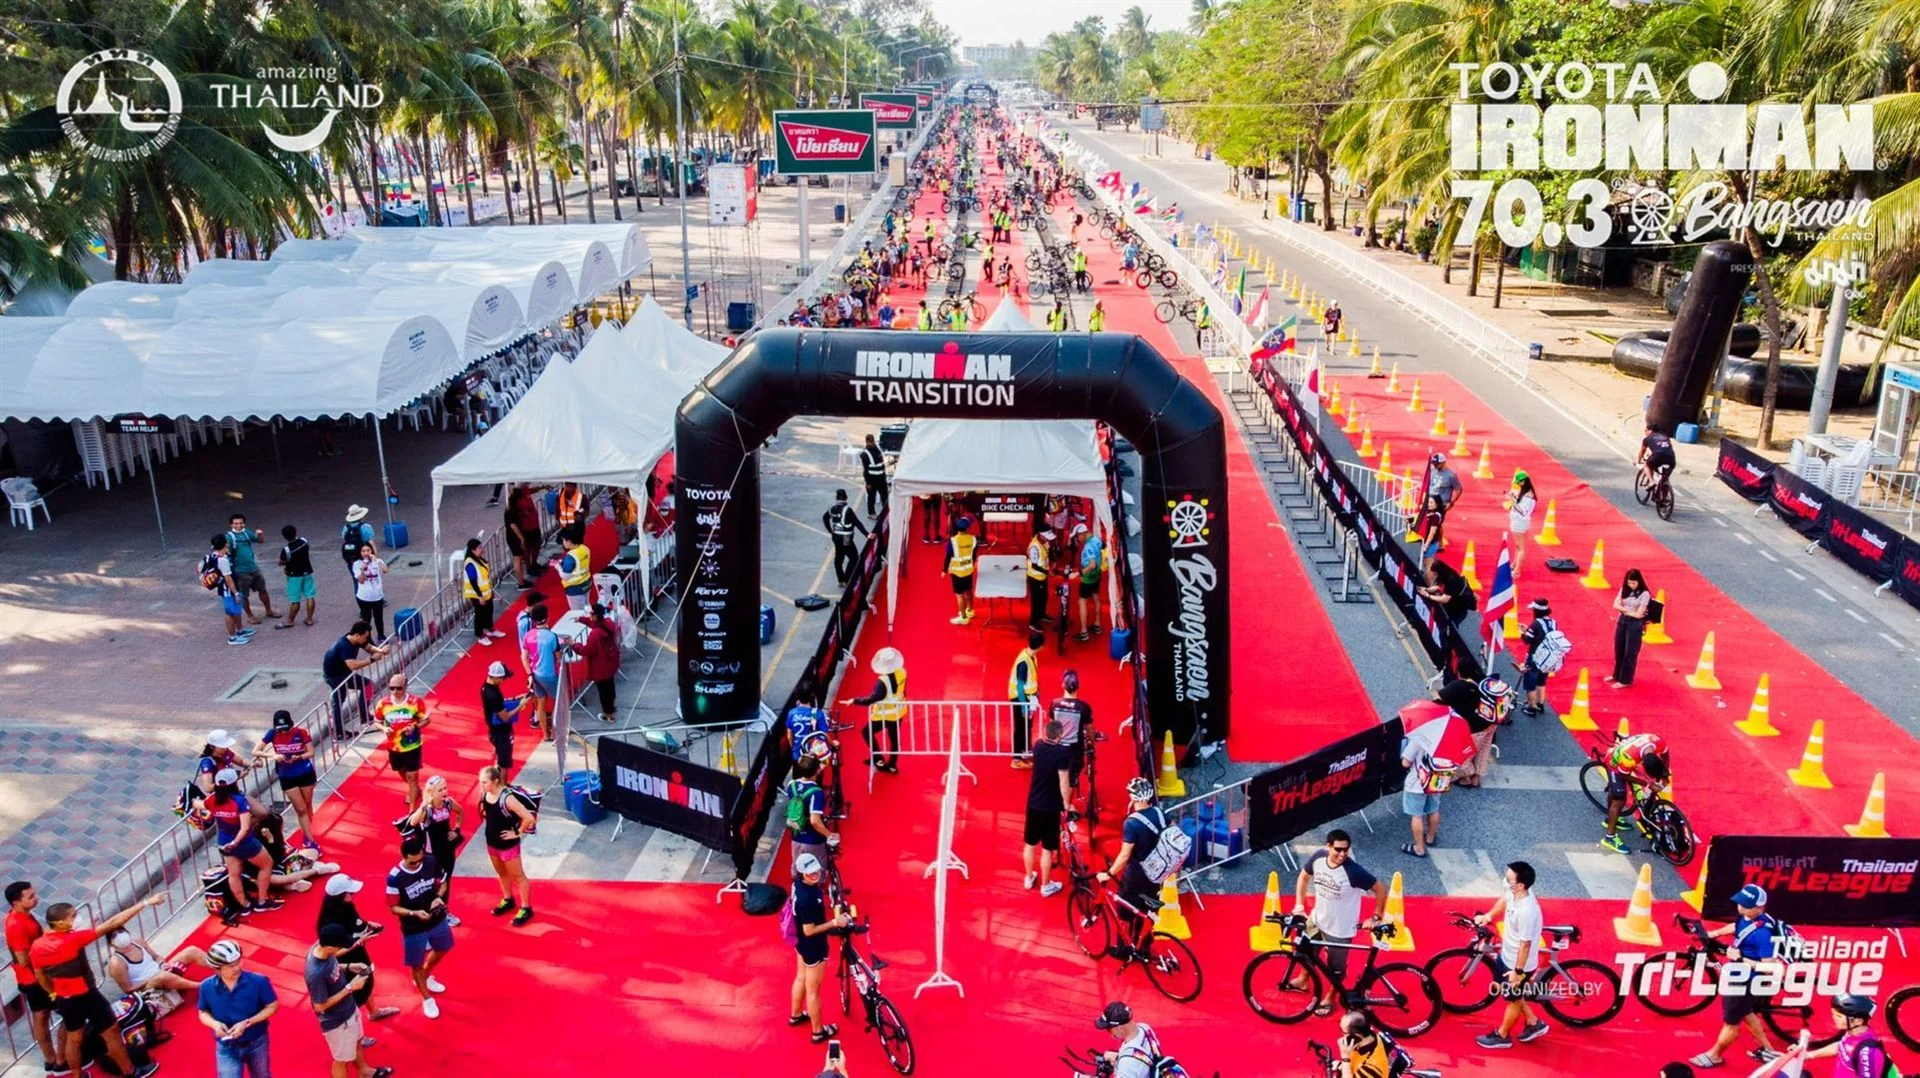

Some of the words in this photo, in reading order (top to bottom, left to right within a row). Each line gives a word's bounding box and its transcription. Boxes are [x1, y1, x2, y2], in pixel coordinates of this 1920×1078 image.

[855, 350, 1012, 381] IRONMAN
[849, 380, 1015, 406] TRANSITION
[685, 487, 732, 500] TOYOTA
[1168, 553, 1217, 701] Bangsaen
[1173, 642, 1184, 702] THAILAND
[1328, 747, 1367, 774] Thailand
[616, 765, 723, 818] IRONMAN
[1271, 762, 1366, 815] Tri-League
[1842, 859, 1919, 873] Thailand
[1742, 866, 1914, 898] Tri-League
